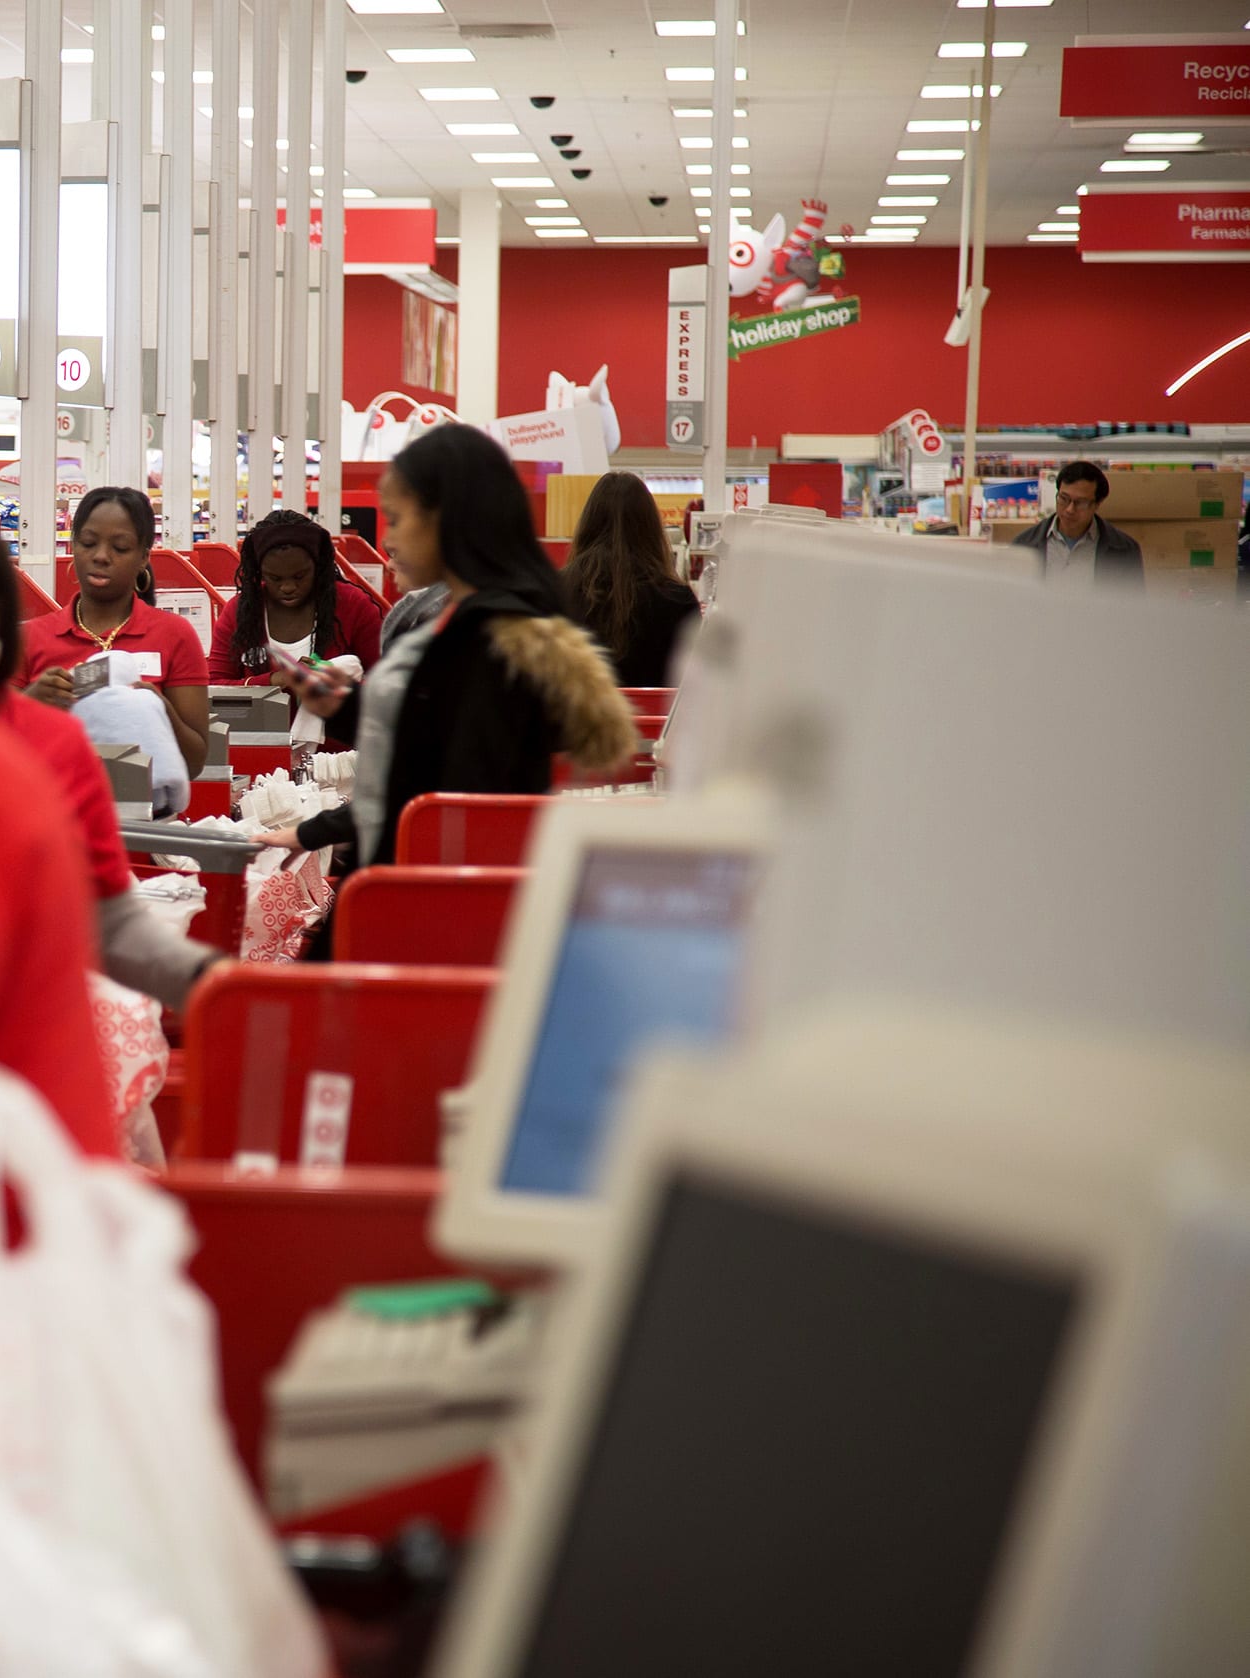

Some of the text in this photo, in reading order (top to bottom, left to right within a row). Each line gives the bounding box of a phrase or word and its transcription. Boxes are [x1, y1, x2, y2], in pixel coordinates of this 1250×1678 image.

[731, 306, 850, 349] holiday shop
[677, 310, 690, 396] EXPRESS
[60, 360, 81, 382] 10
[57, 415, 70, 431] 16
[508, 419, 556, 436] bullseye's
[675, 421, 690, 437] 17
[510, 427, 565, 448] playground
